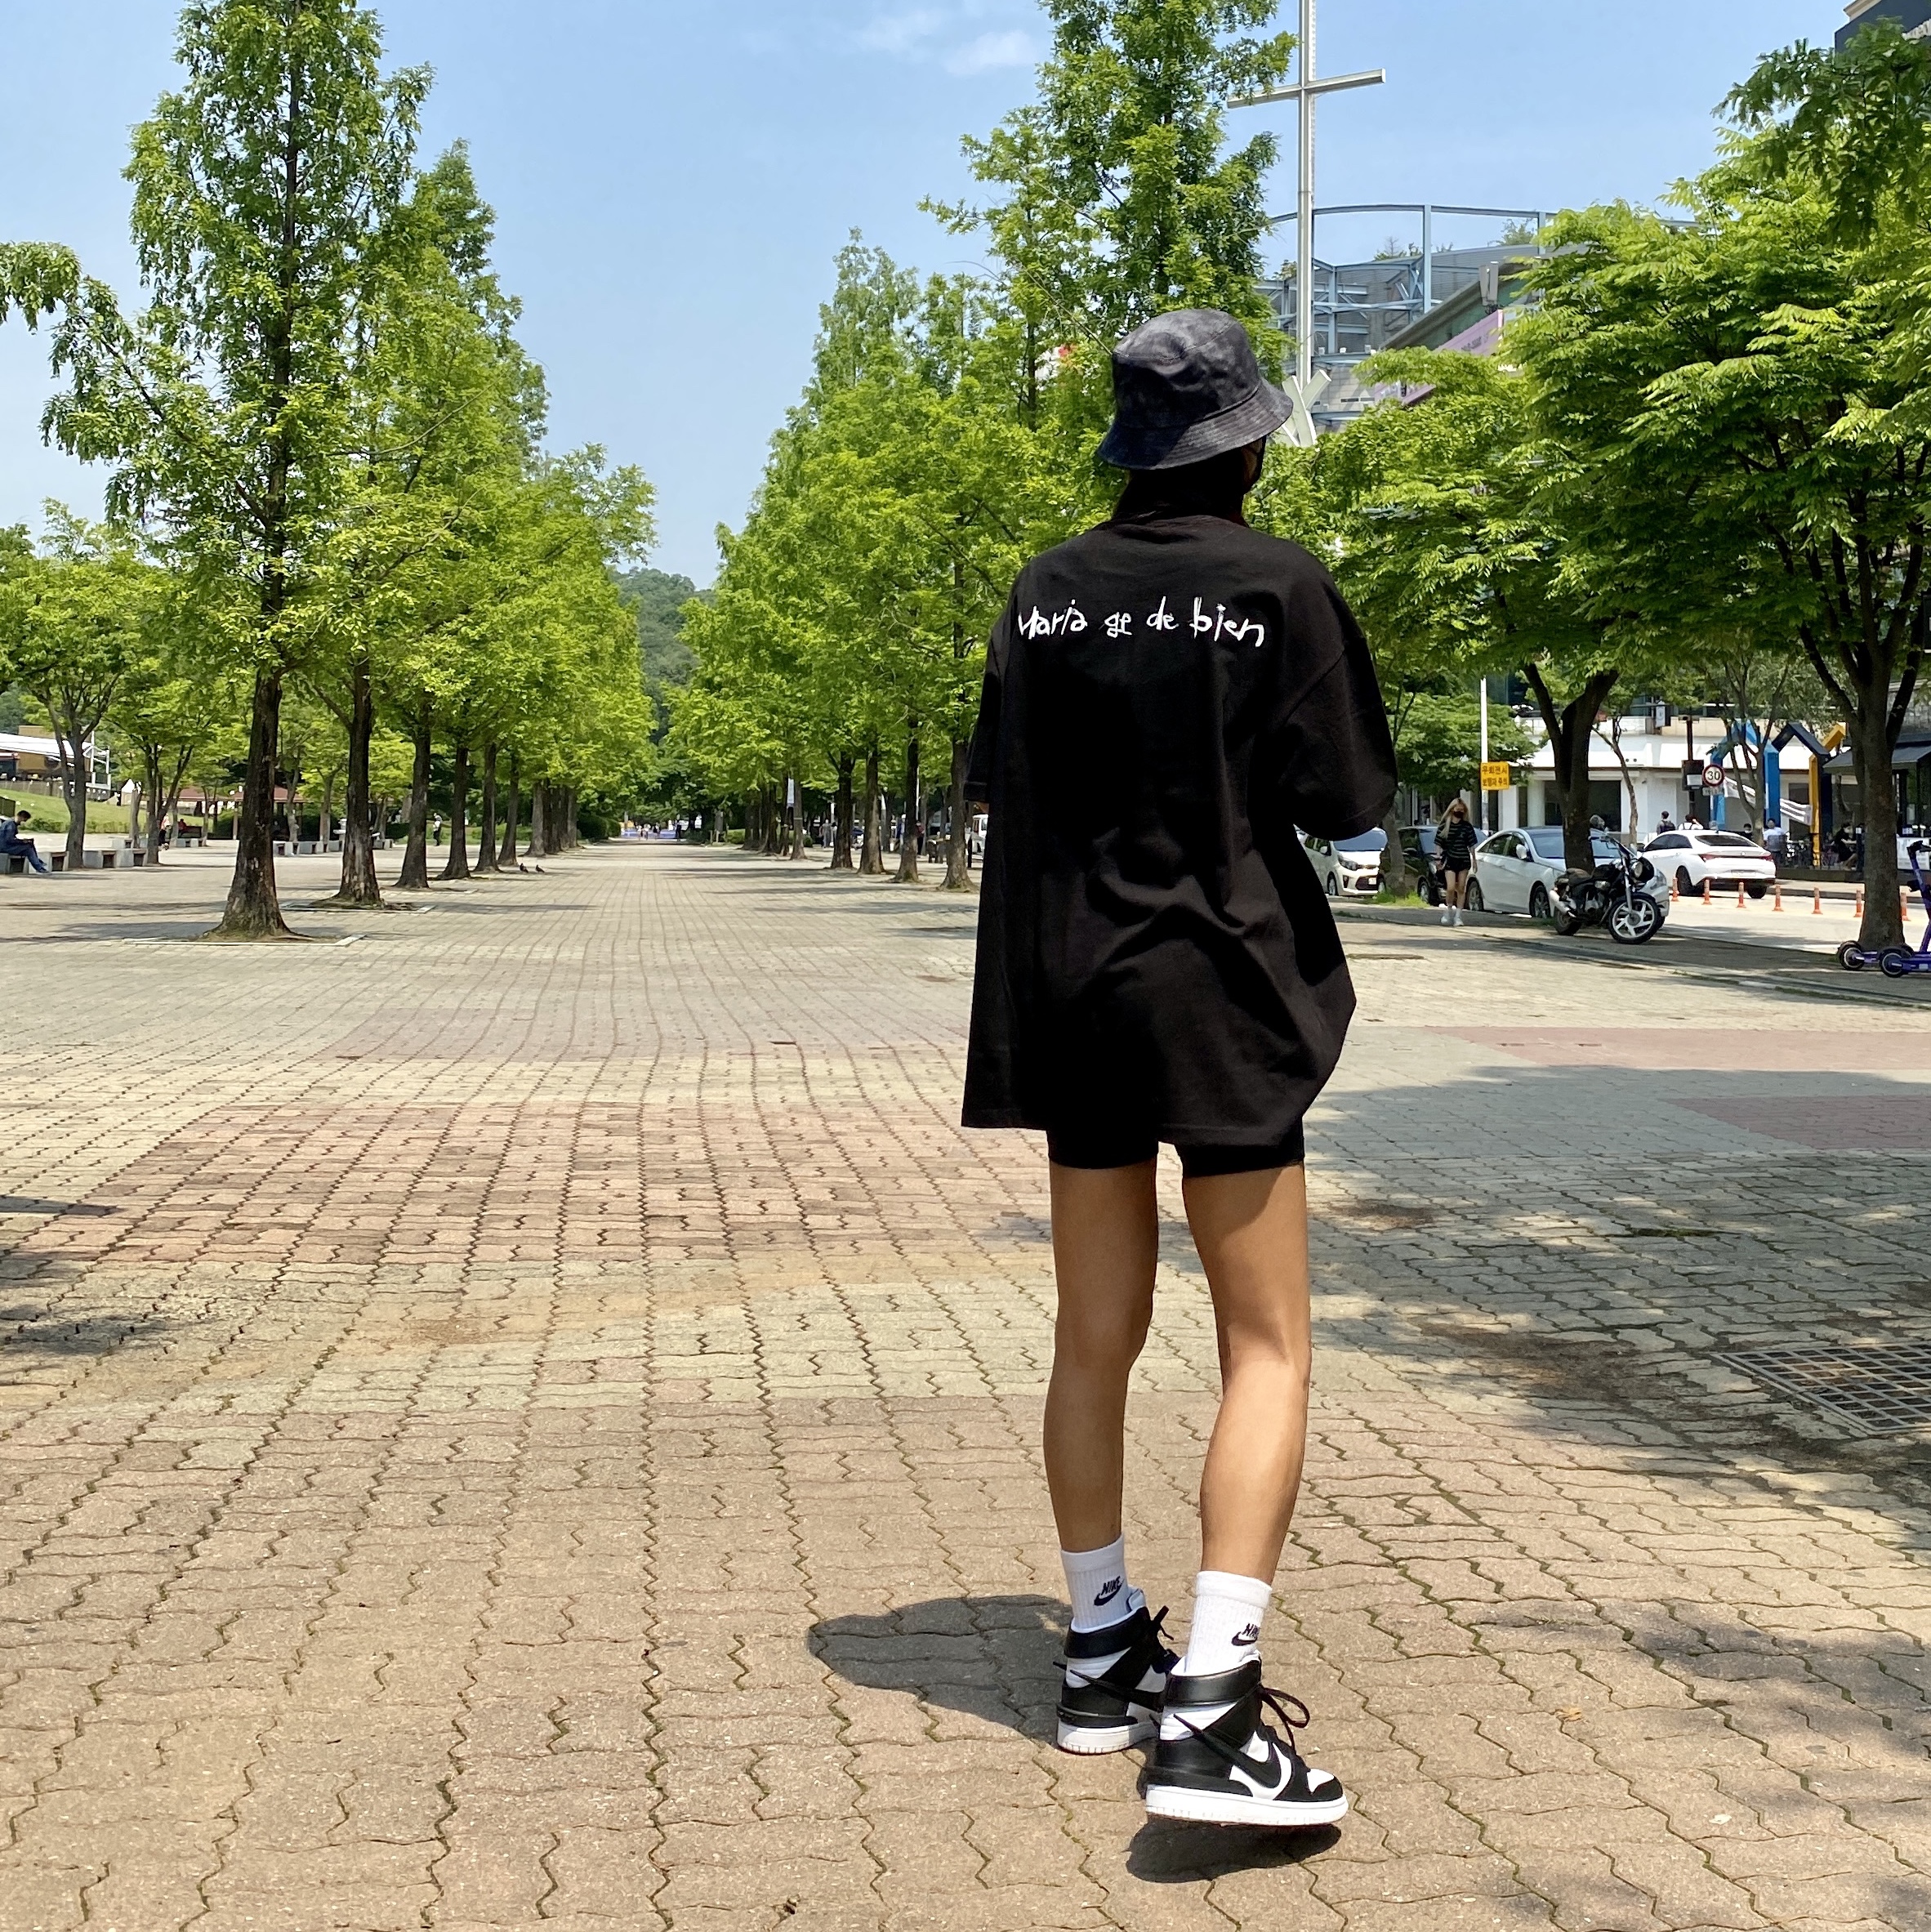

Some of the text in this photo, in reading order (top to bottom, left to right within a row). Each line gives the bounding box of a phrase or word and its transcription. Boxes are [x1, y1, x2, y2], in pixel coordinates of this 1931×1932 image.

[1146, 596, 1180, 631] de
[1189, 596, 1265, 648] bien
[1707, 770, 1721, 781] 30
[1100, 1575, 1122, 1595] NIKE
